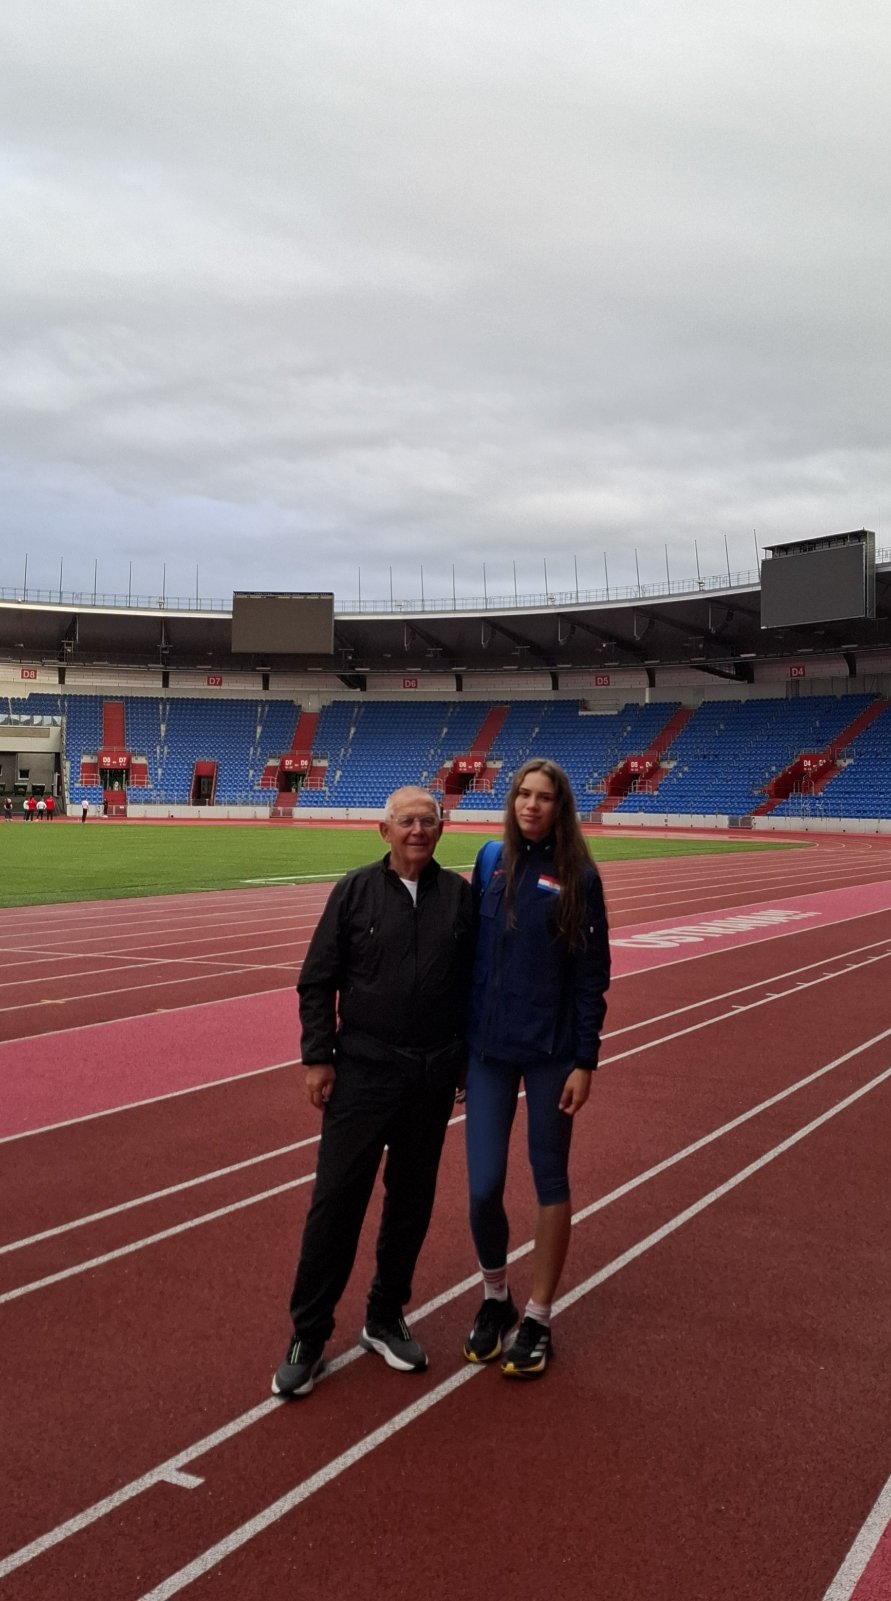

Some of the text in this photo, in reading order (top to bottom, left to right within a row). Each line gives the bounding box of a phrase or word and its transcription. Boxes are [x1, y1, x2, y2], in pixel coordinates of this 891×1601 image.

[23, 670, 35, 679] D8
[792, 668, 803, 676] D4
[209, 677, 220, 685] D7
[597, 677, 609, 685] D5
